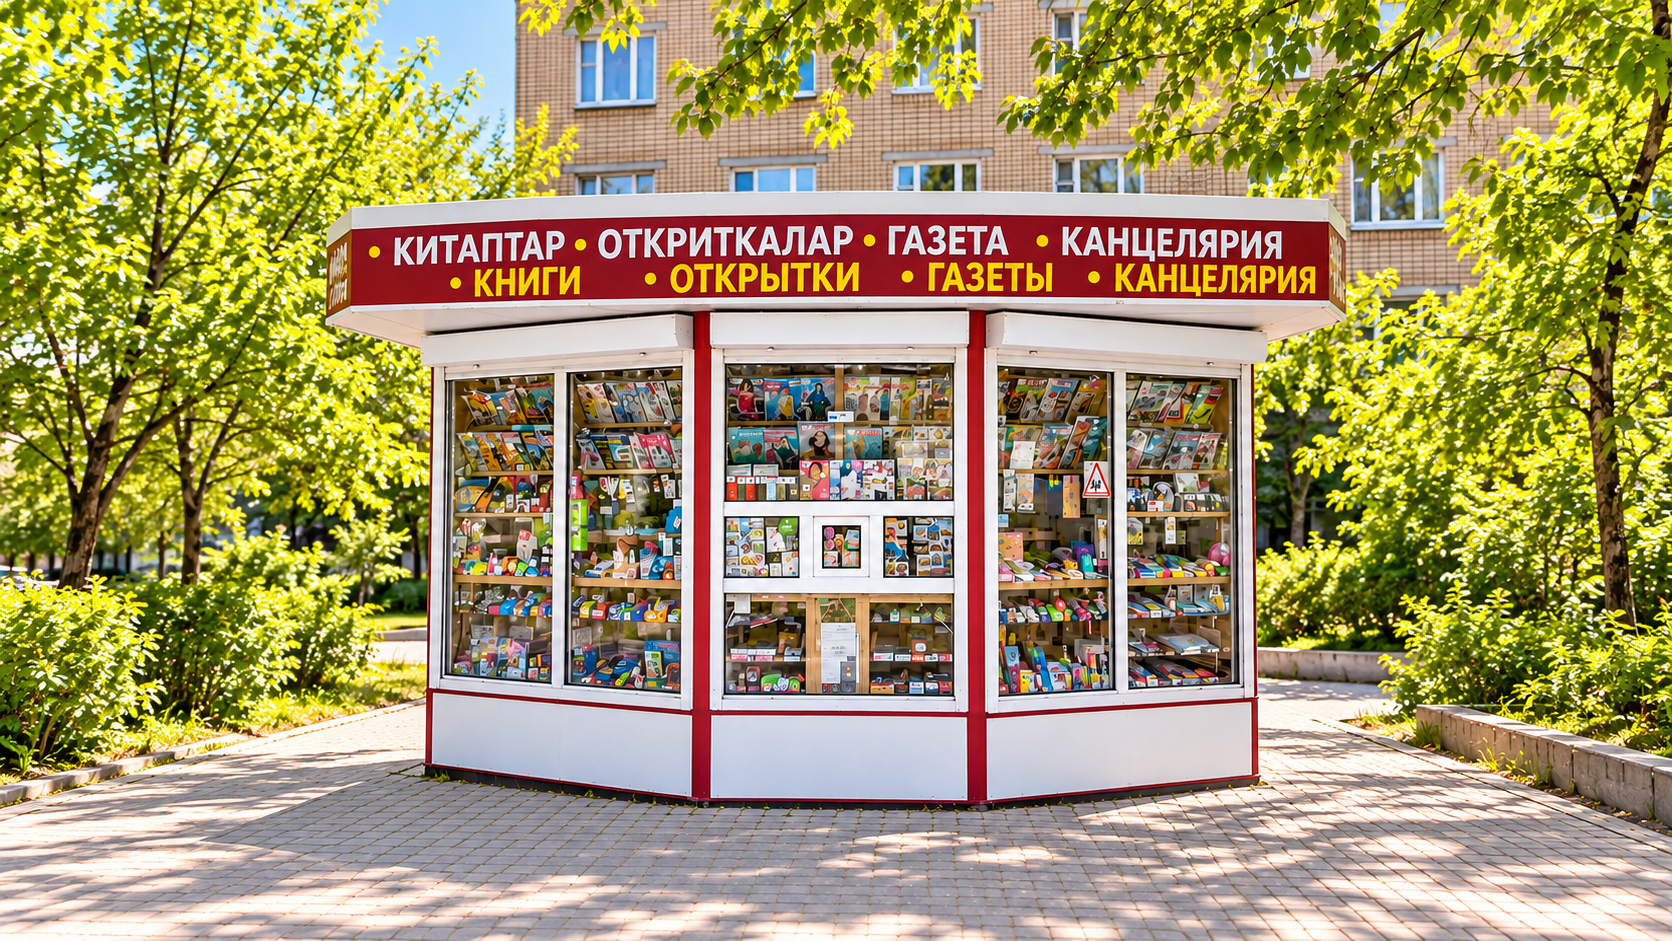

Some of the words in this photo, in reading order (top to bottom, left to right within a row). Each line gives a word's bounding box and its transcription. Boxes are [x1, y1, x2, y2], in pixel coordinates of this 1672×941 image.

[393, 230, 565, 266] КИТАПТАР
[597, 225, 854, 260] ОТКРИТКАЛАР
[887, 224, 1009, 256] ГАЗЕТА
[1061, 226, 1283, 262] КАНЦЕЛЯРИЯ
[474, 265, 581, 297] КНИГИ
[670, 262, 860, 294] ОТКРЫТКИ
[928, 261, 1053, 292] ГАЗЕТЫ
[1115, 265, 1317, 297] КАНЦЕЛЯРИЯ
